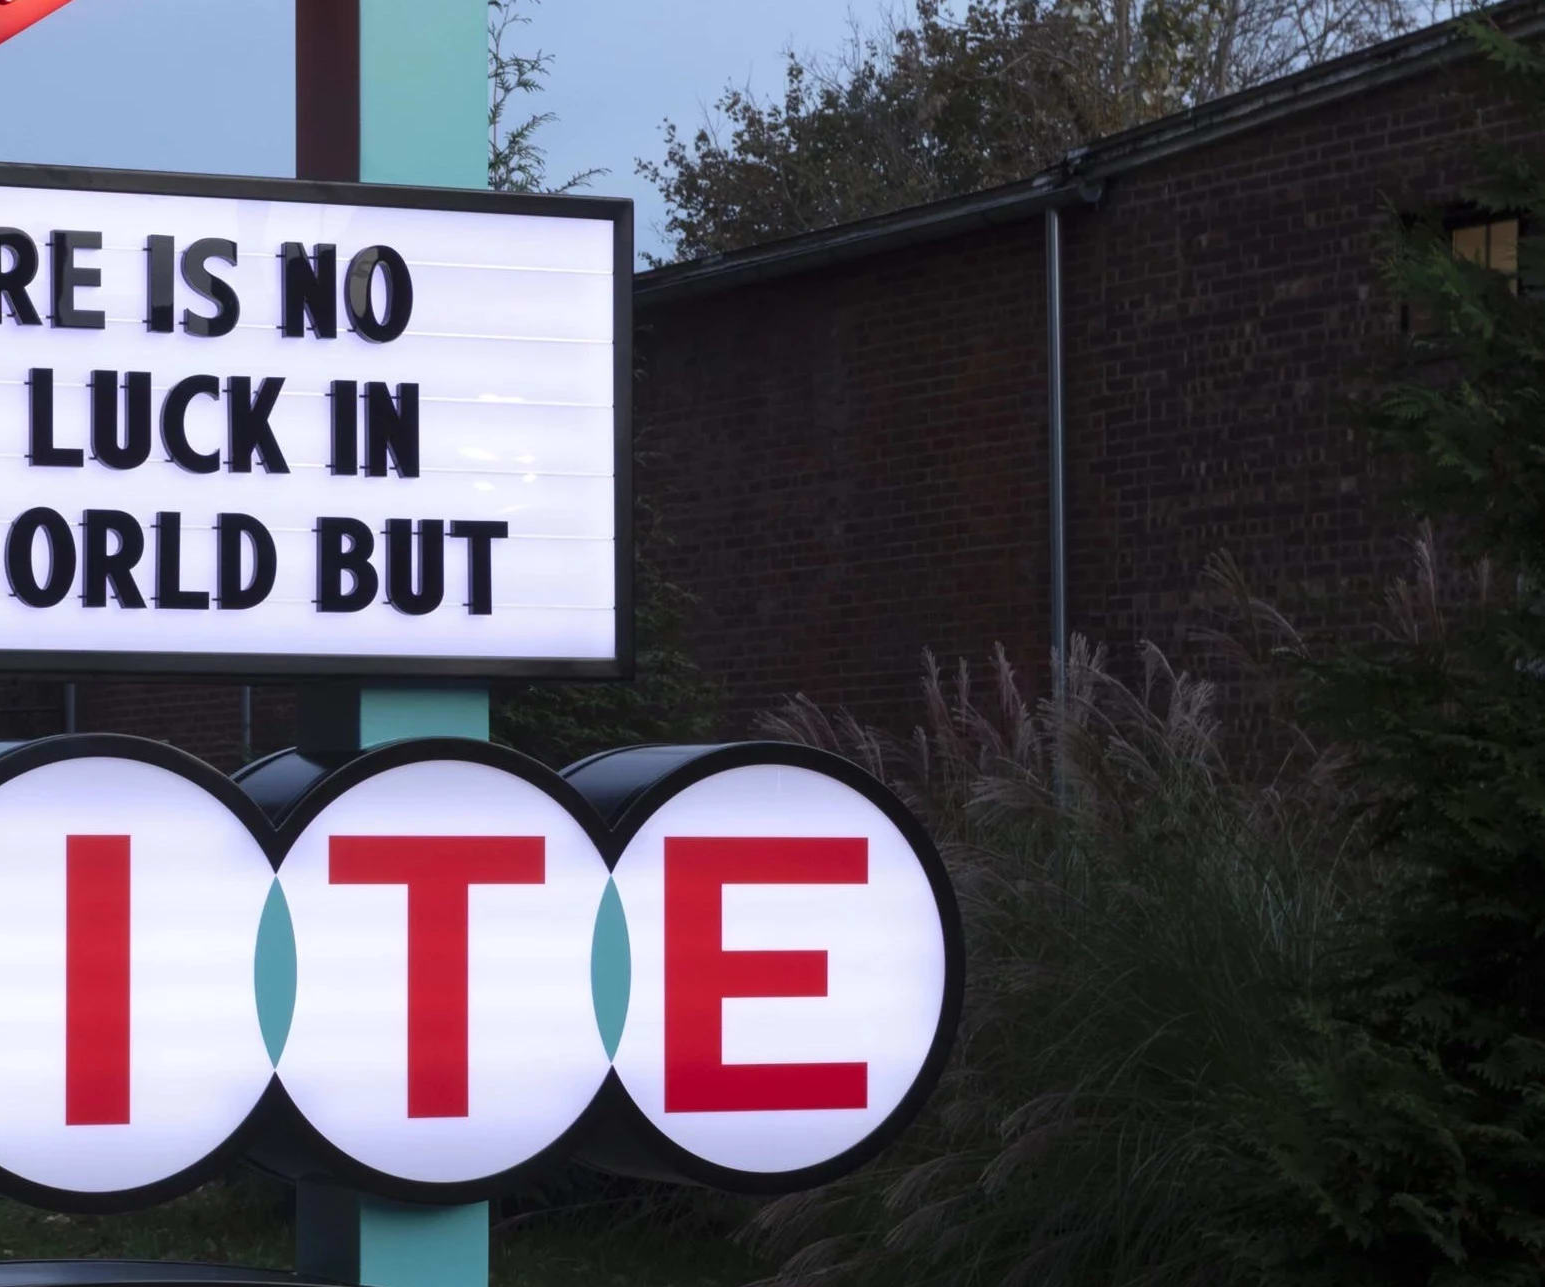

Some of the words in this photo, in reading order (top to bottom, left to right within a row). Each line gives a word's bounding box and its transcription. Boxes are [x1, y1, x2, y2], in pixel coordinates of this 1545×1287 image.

[143, 234, 240, 338] IS
[279, 241, 414, 344] NO
[27, 367, 290, 475] LUCK
[328, 379, 420, 479] IN
[314, 516, 509, 616] BUT
